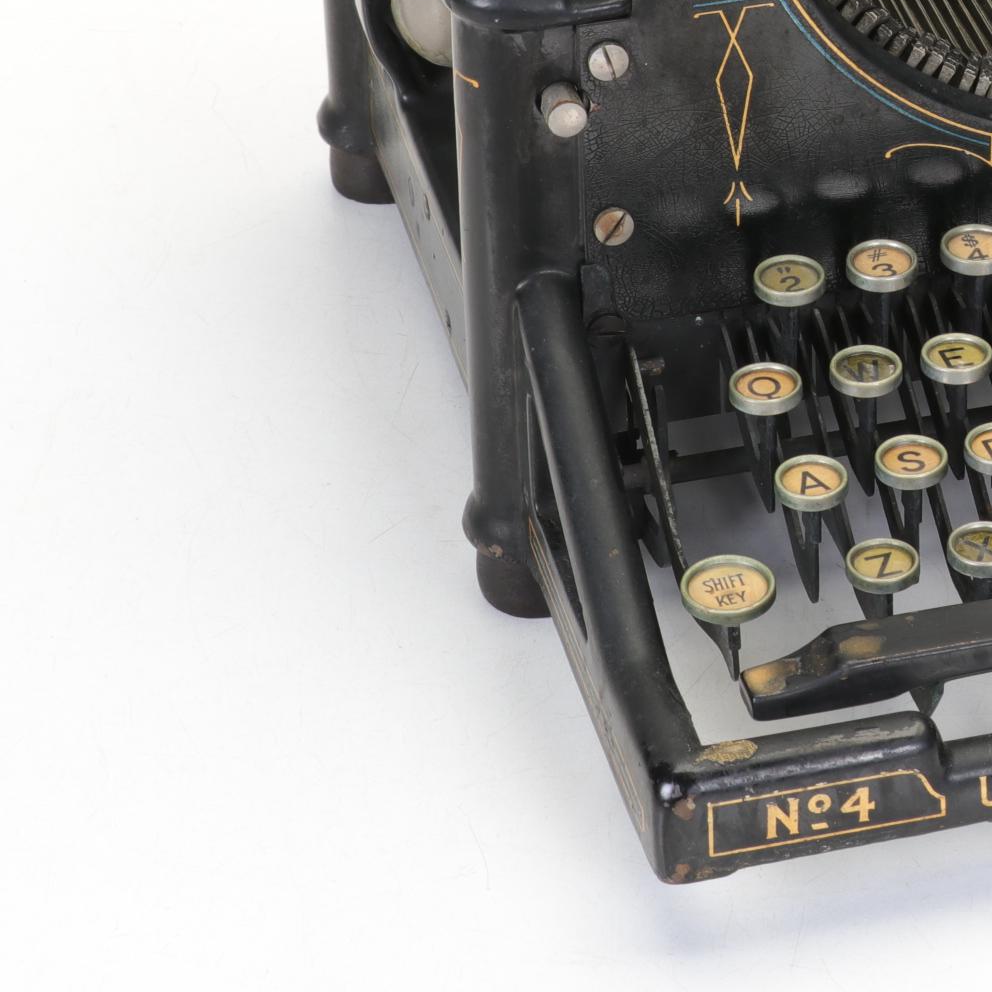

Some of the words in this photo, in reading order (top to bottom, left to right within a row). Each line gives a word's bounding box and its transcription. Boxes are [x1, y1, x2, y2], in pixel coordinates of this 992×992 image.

[871, 262, 898, 278] 3
[779, 275, 806, 292] 2
[938, 346, 976, 370] E
[747, 376, 782, 399] Q
[896, 450, 927, 474] S
[799, 470, 833, 496] A
[863, 551, 905, 580] Z
[701, 573, 746, 595] SHIFT
[715, 590, 748, 609] KEY
[840, 786, 877, 823] 4
